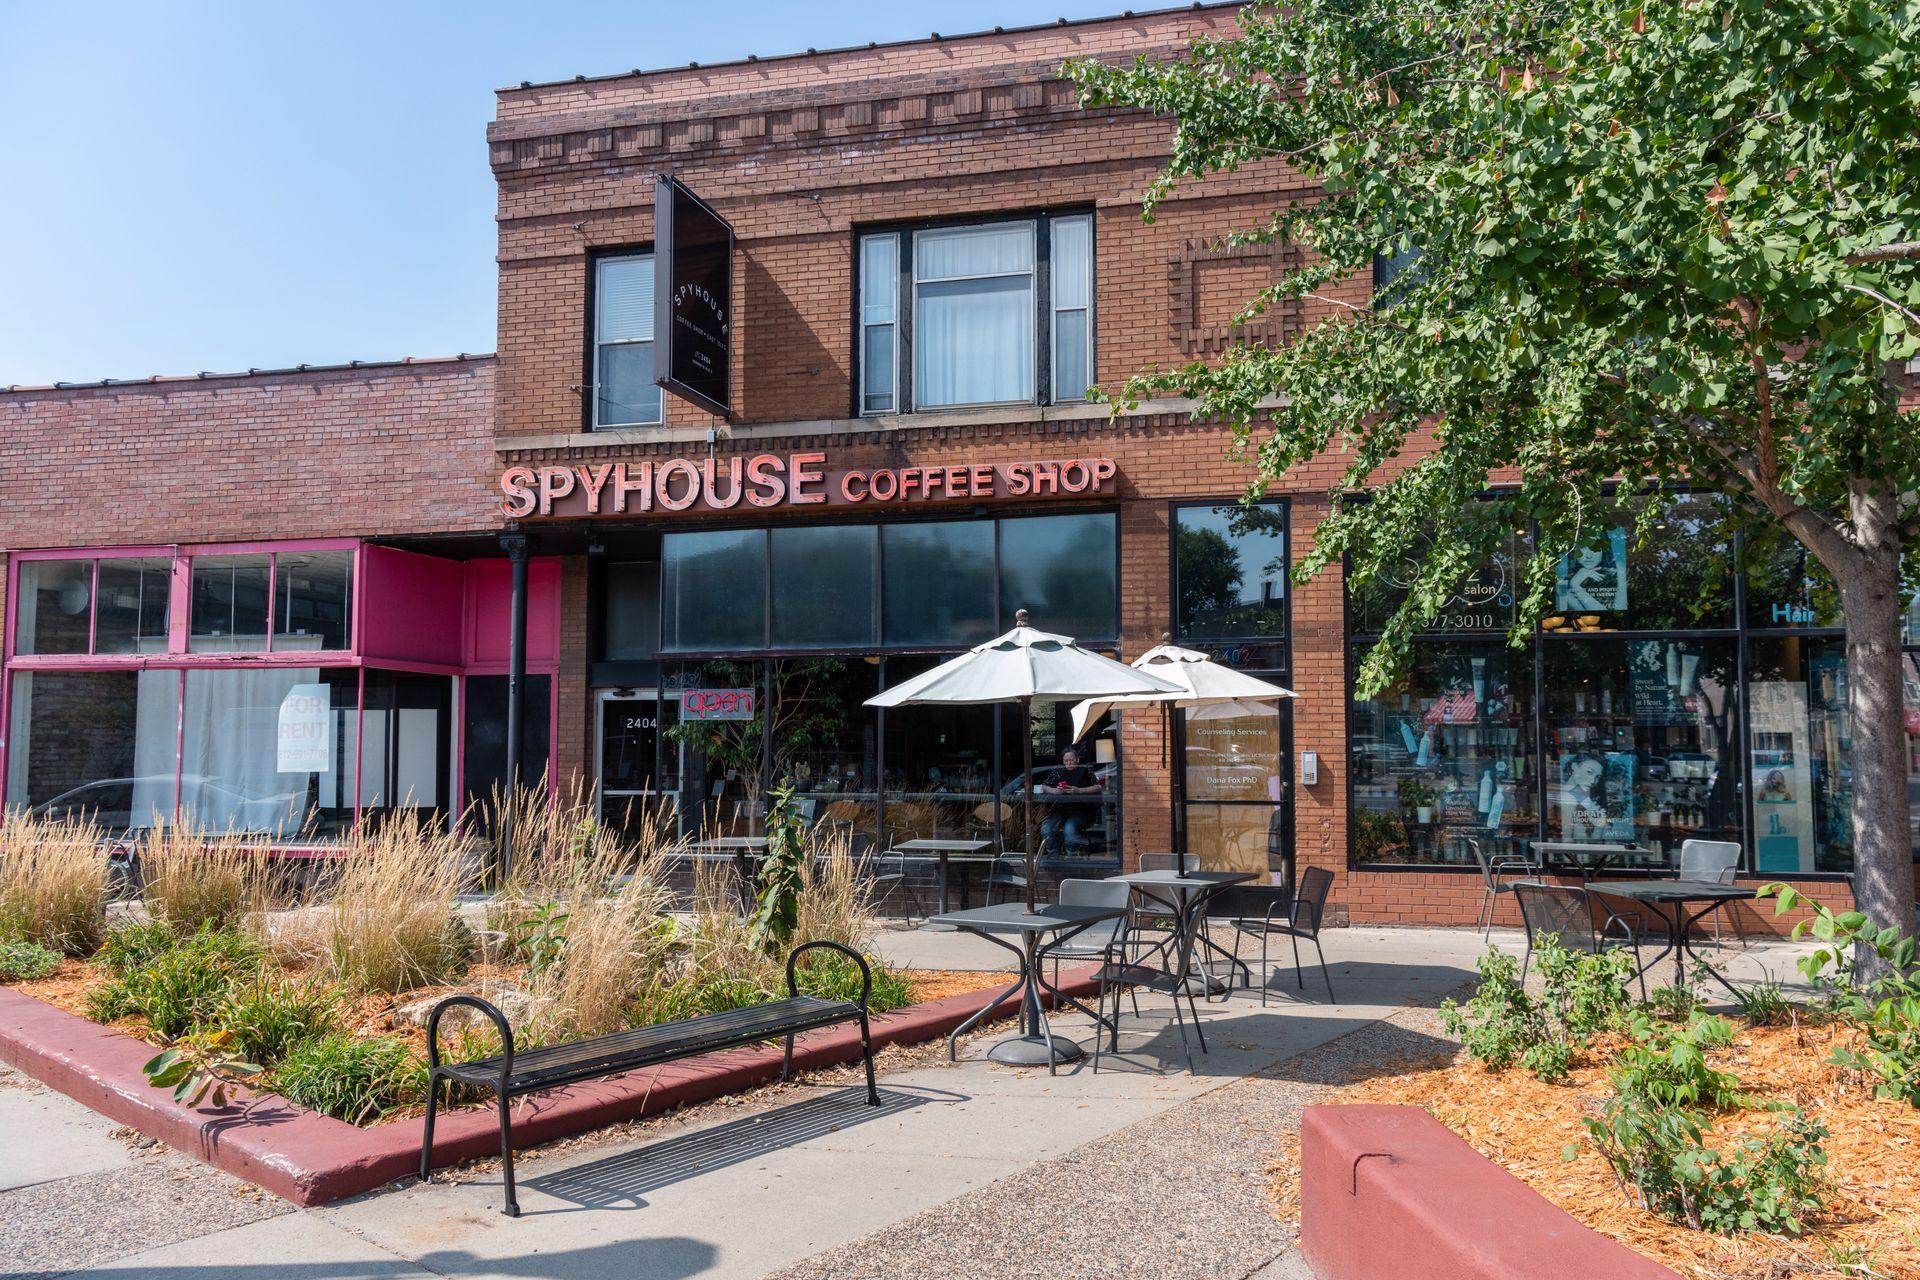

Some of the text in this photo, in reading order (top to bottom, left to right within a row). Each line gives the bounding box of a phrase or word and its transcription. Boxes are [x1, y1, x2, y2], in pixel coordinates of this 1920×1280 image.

[501, 452, 1116, 518] SPYHOUSE COFFEE SHOP
[1464, 584, 1496, 595] salon
[1772, 603, 1815, 623] Hair
[284, 697, 324, 714] FOR
[280, 722, 327, 739] RENT
[626, 718, 657, 729] 2404
[1197, 728, 1267, 736] Counseling Services
[1242, 776, 1258, 784] PhD
